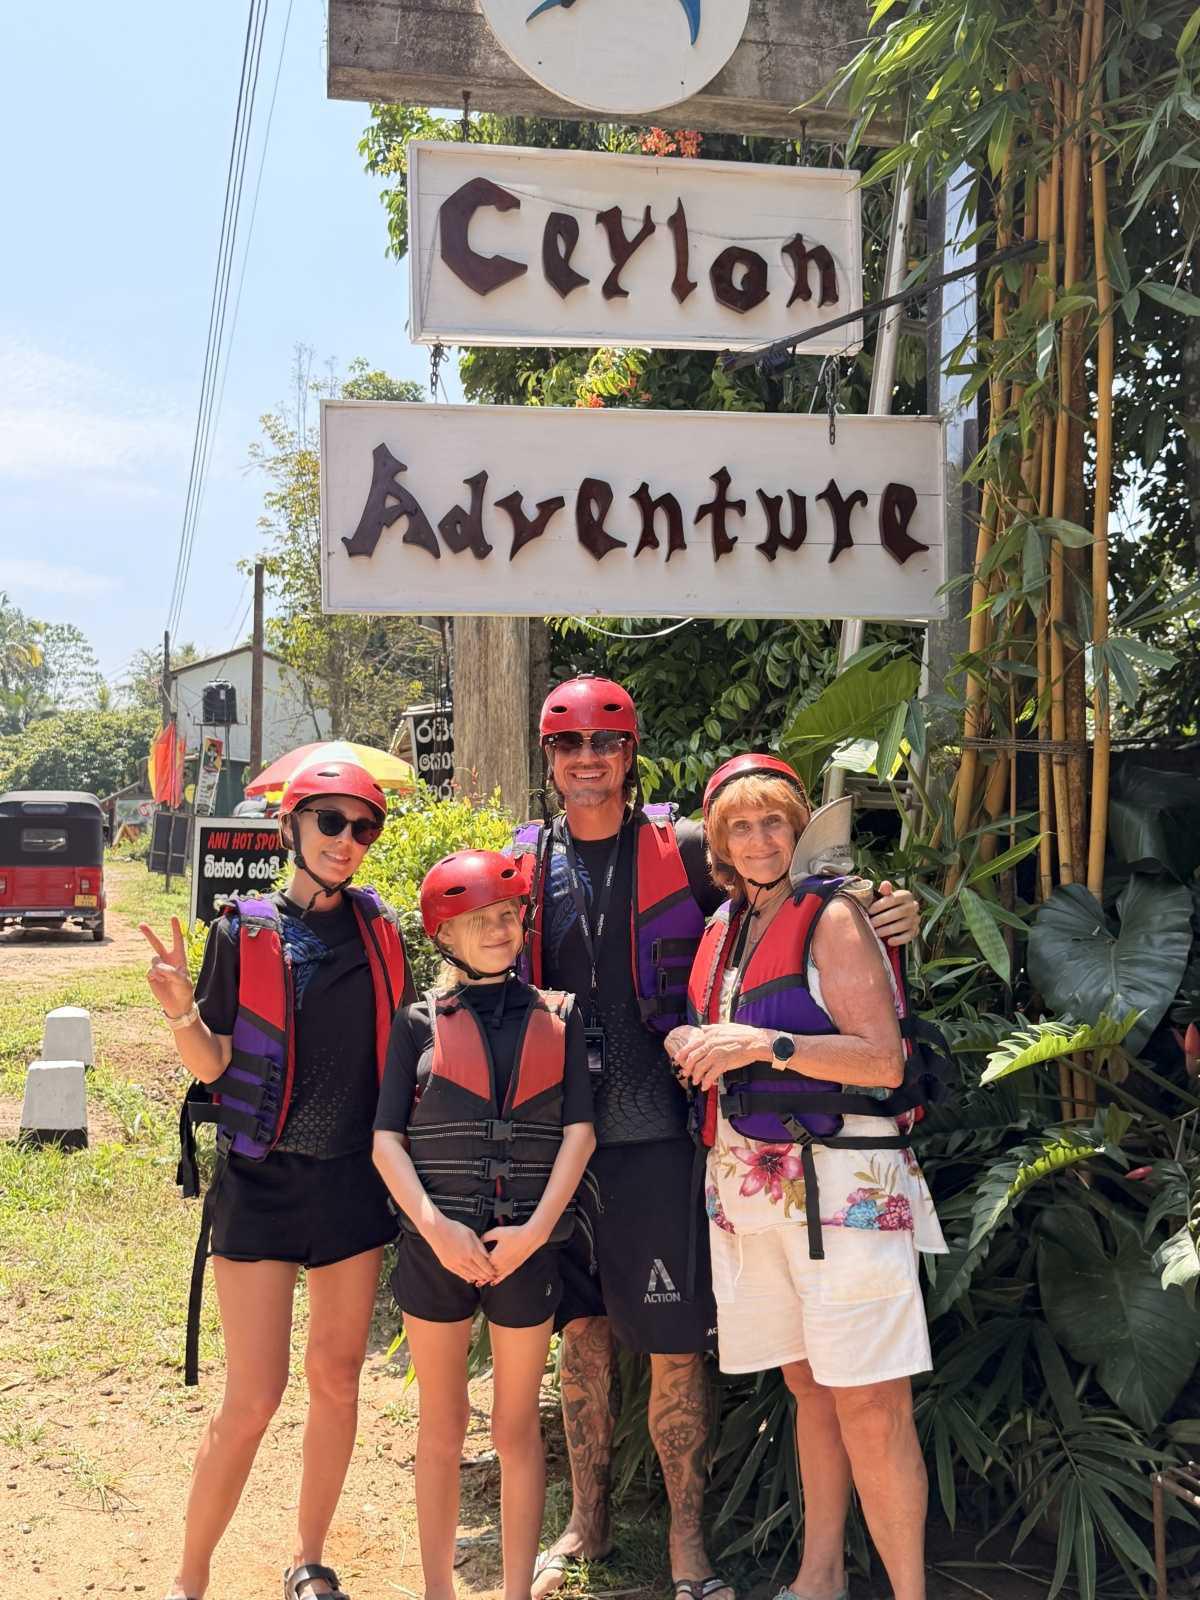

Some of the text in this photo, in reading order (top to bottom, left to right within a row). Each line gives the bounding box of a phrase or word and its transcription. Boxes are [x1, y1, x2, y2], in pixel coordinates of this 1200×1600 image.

[439, 176, 841, 314] Ceylon
[341, 442, 930, 566] Adventure
[207, 832, 230, 850] ANU
[231, 832, 255, 851] HOT
[643, 1292, 681, 1304] ACTION
